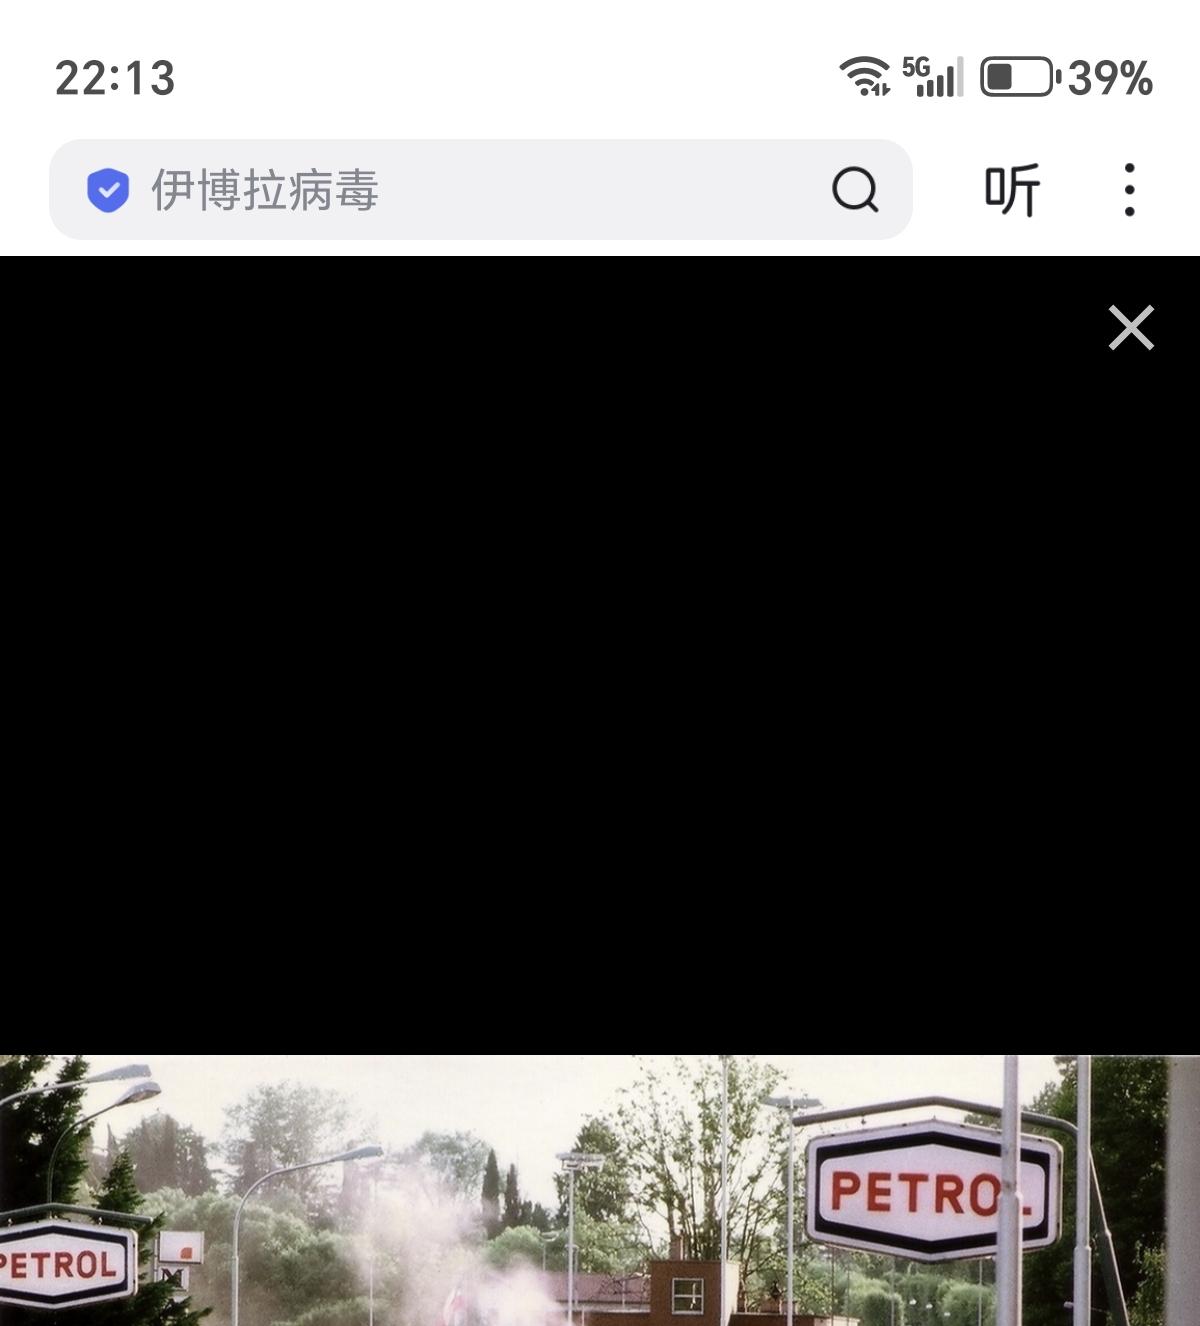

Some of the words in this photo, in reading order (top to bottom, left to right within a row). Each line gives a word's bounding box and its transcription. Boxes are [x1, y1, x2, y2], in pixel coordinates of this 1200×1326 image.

[55, 59, 175, 96] 22:13
[902, 56, 930, 77] 5G
[1068, 59, 1154, 96] 39%
[151, 167, 379, 212] 伊博拉病毒
[985, 163, 1041, 218] 听
[832, 1171, 1032, 1217] PETRO
